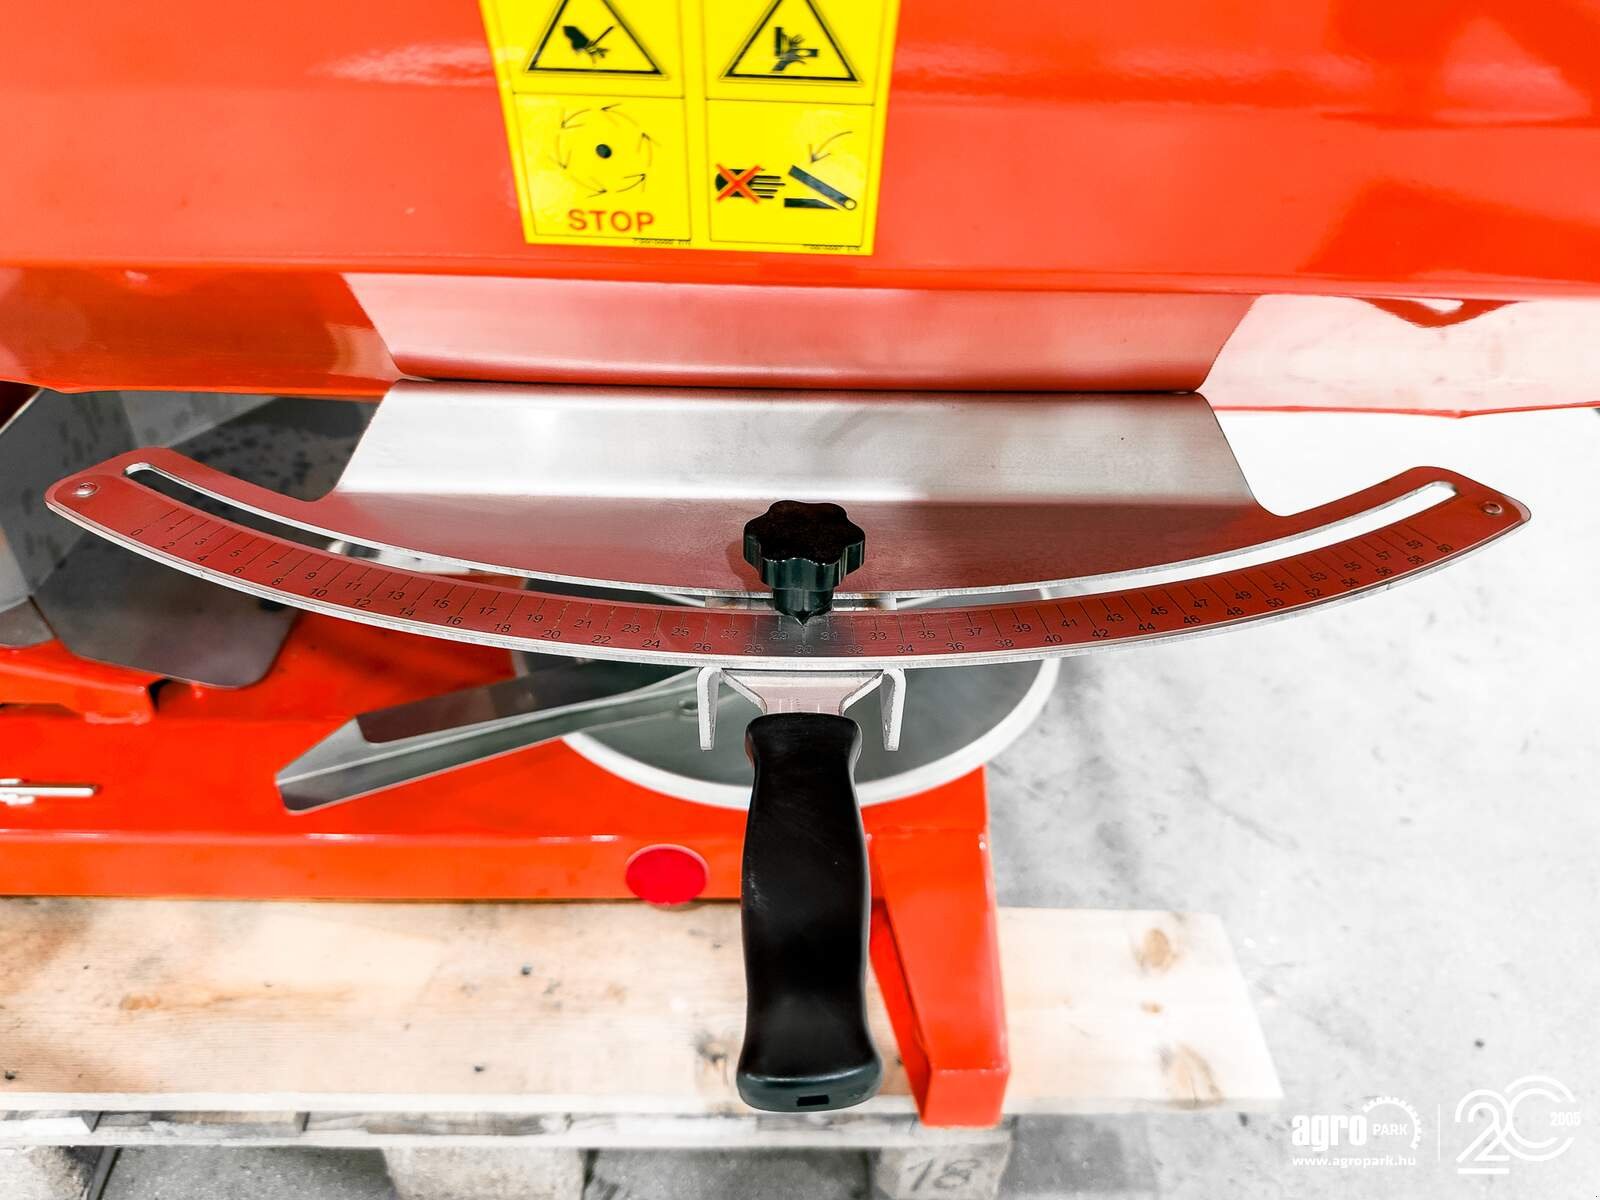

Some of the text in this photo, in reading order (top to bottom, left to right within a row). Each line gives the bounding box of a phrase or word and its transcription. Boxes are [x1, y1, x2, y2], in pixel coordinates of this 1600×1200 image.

[568, 209, 655, 233] STOP
[310, 588, 328, 598] 10
[352, 598, 372, 608] 12
[400, 608, 416, 617] 14
[446, 616, 464, 626] 16
[494, 623, 512, 632] 18
[542, 630, 560, 640] 20
[592, 635, 611, 644] 22
[642, 639, 660, 648] 24
[693, 642, 712, 652] 26
[848, 645, 864, 654] 32
[897, 644, 914, 653] 34
[946, 642, 965, 651] 36
[996, 639, 1014, 648] 38
[1044, 634, 1062, 643] 40
[1092, 628, 1110, 638] 42
[1138, 622, 1156, 631] 44
[1184, 615, 1200, 624] 46
[1226, 606, 1244, 616] 48
[1266, 598, 1284, 608] 50
[1304, 588, 1324, 598] 52
[345, 582, 362, 590] 11
[386, 590, 405, 600] 13
[432, 598, 450, 608] 15
[480, 606, 496, 616] 17
[527, 614, 544, 624] 19
[574, 619, 592, 629] 21
[621, 624, 640, 634] 23
[672, 627, 690, 636] 25
[720, 630, 738, 640] 27
[870, 632, 887, 640] 33
[919, 630, 936, 639] 35
[966, 628, 982, 636] 37
[1013, 624, 1032, 632] 39
[1062, 618, 1078, 628] 41
[1106, 613, 1124, 622] 43
[1150, 606, 1168, 616] 45
[1193, 600, 1208, 608] 47
[1235, 591, 1252, 600] 49
[1272, 582, 1290, 592] 51
